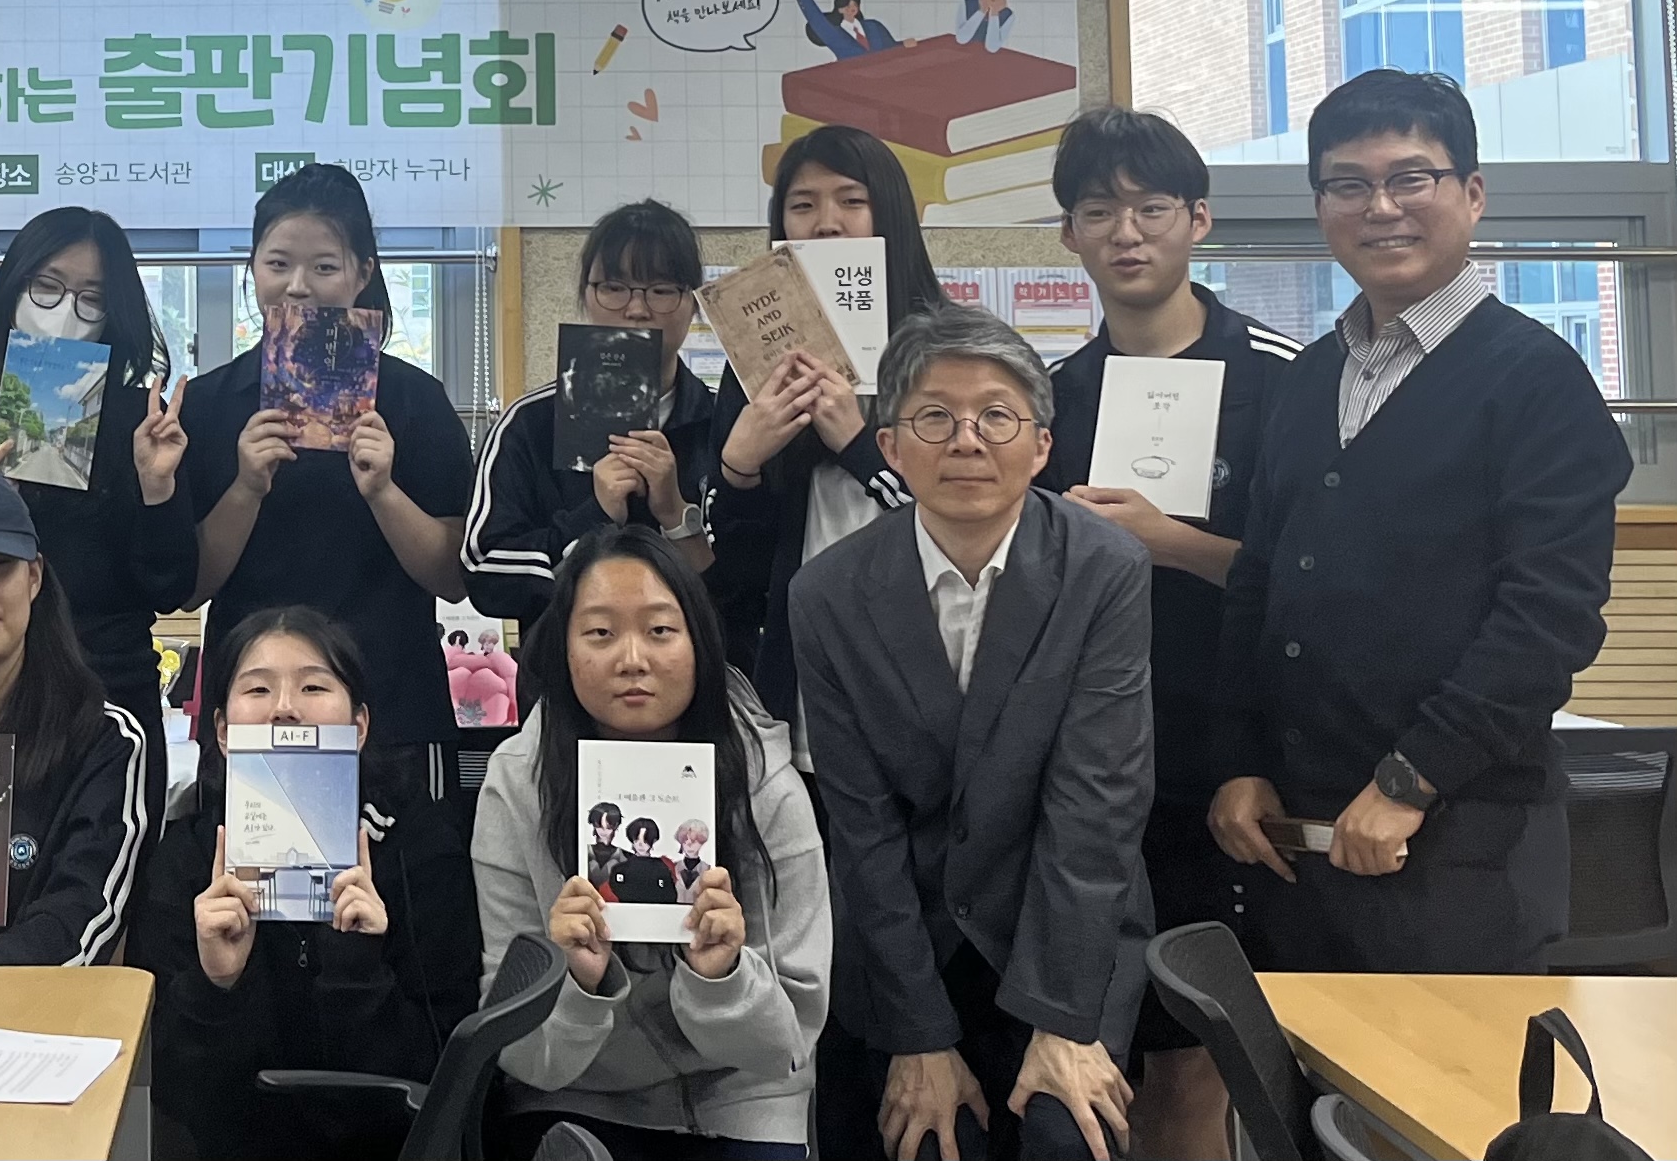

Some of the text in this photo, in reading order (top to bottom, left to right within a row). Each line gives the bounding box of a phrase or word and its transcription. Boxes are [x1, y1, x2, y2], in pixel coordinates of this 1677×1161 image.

[98, 31, 555, 129] 출판기념회
[54, 161, 121, 186] 송양고
[126, 161, 193, 185] 도서관
[404, 157, 471, 182] 누구나
[834, 265, 873, 287] 인생
[741, 289, 781, 317] HYDE
[835, 290, 874, 312] 작품
[757, 309, 782, 329] AND
[760, 322, 796, 346] SEIK
[280, 730, 310, 742] AI-F
